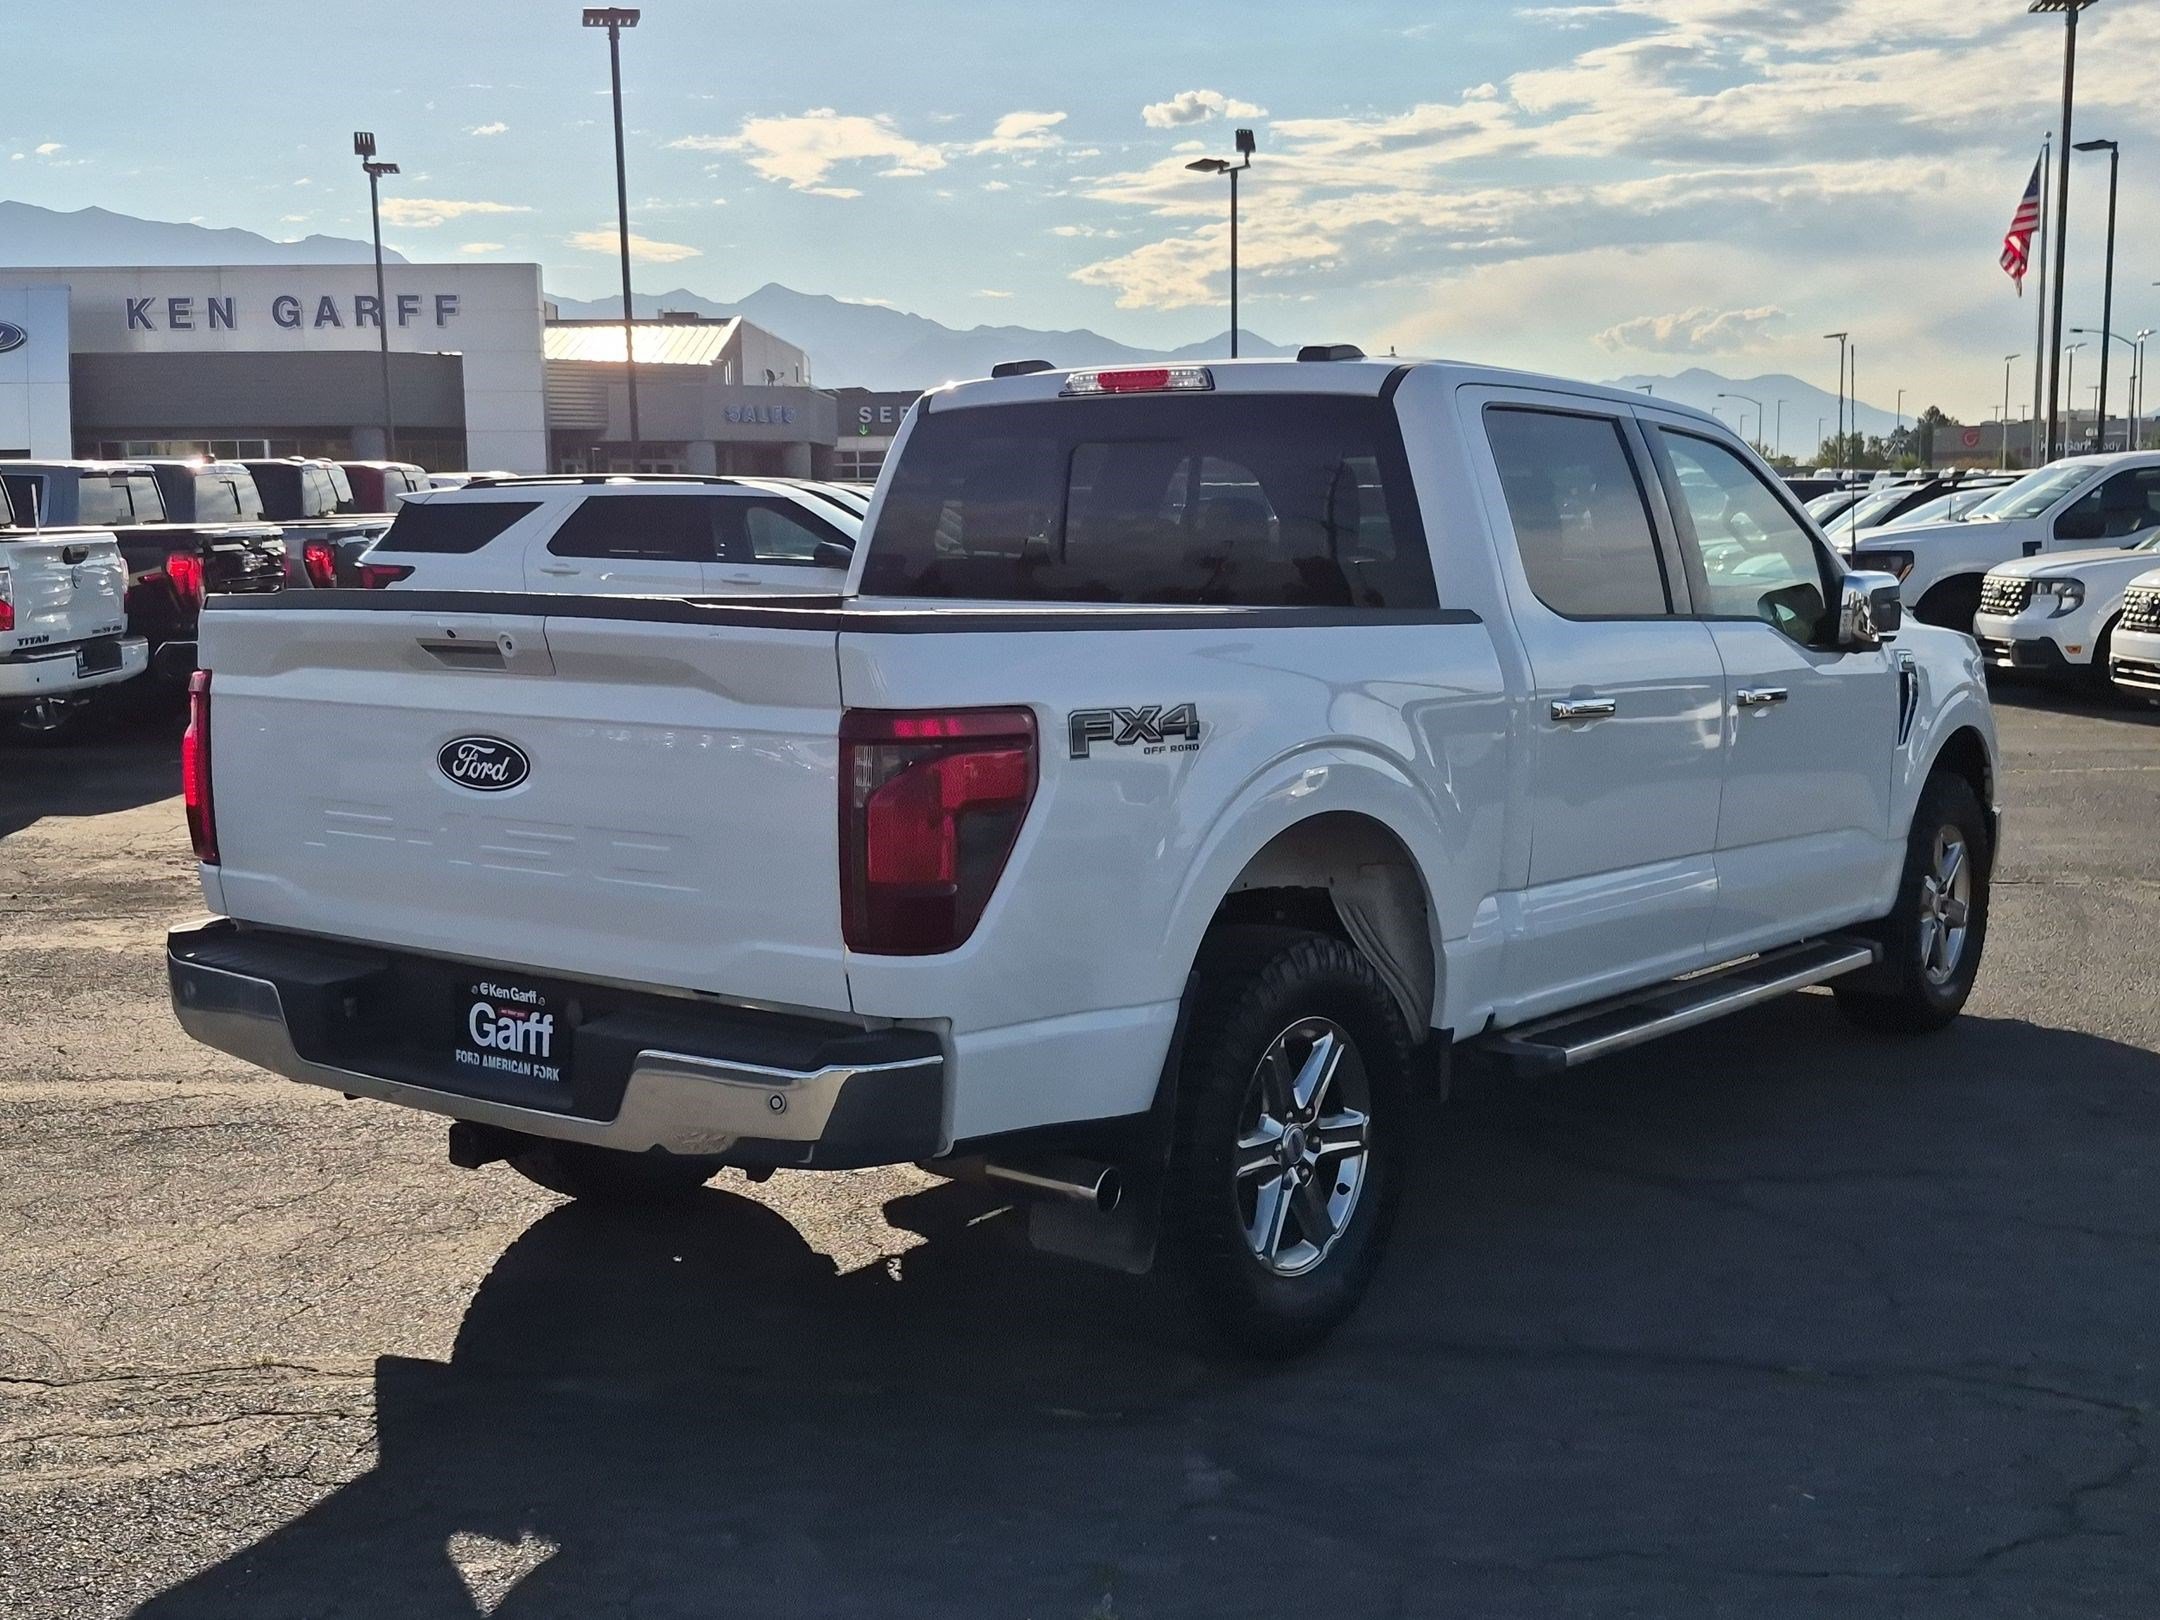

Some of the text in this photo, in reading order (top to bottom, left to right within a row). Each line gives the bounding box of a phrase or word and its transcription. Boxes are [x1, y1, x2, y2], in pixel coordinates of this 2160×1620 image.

[126, 295, 460, 331] KEN GARFF
[726, 404, 796, 424] SALES
[2040, 441, 2063, 452] Kn
[17, 634, 50, 647] TITAN
[1067, 702, 1200, 760] FX4
[452, 743, 511, 782] Ford
[1143, 743, 1200, 755] OFF ROAD
[489, 983, 537, 1004] Ken Garff
[469, 1001, 554, 1058] Garff
[455, 1048, 560, 1082] FORD AMERICAN FORK
